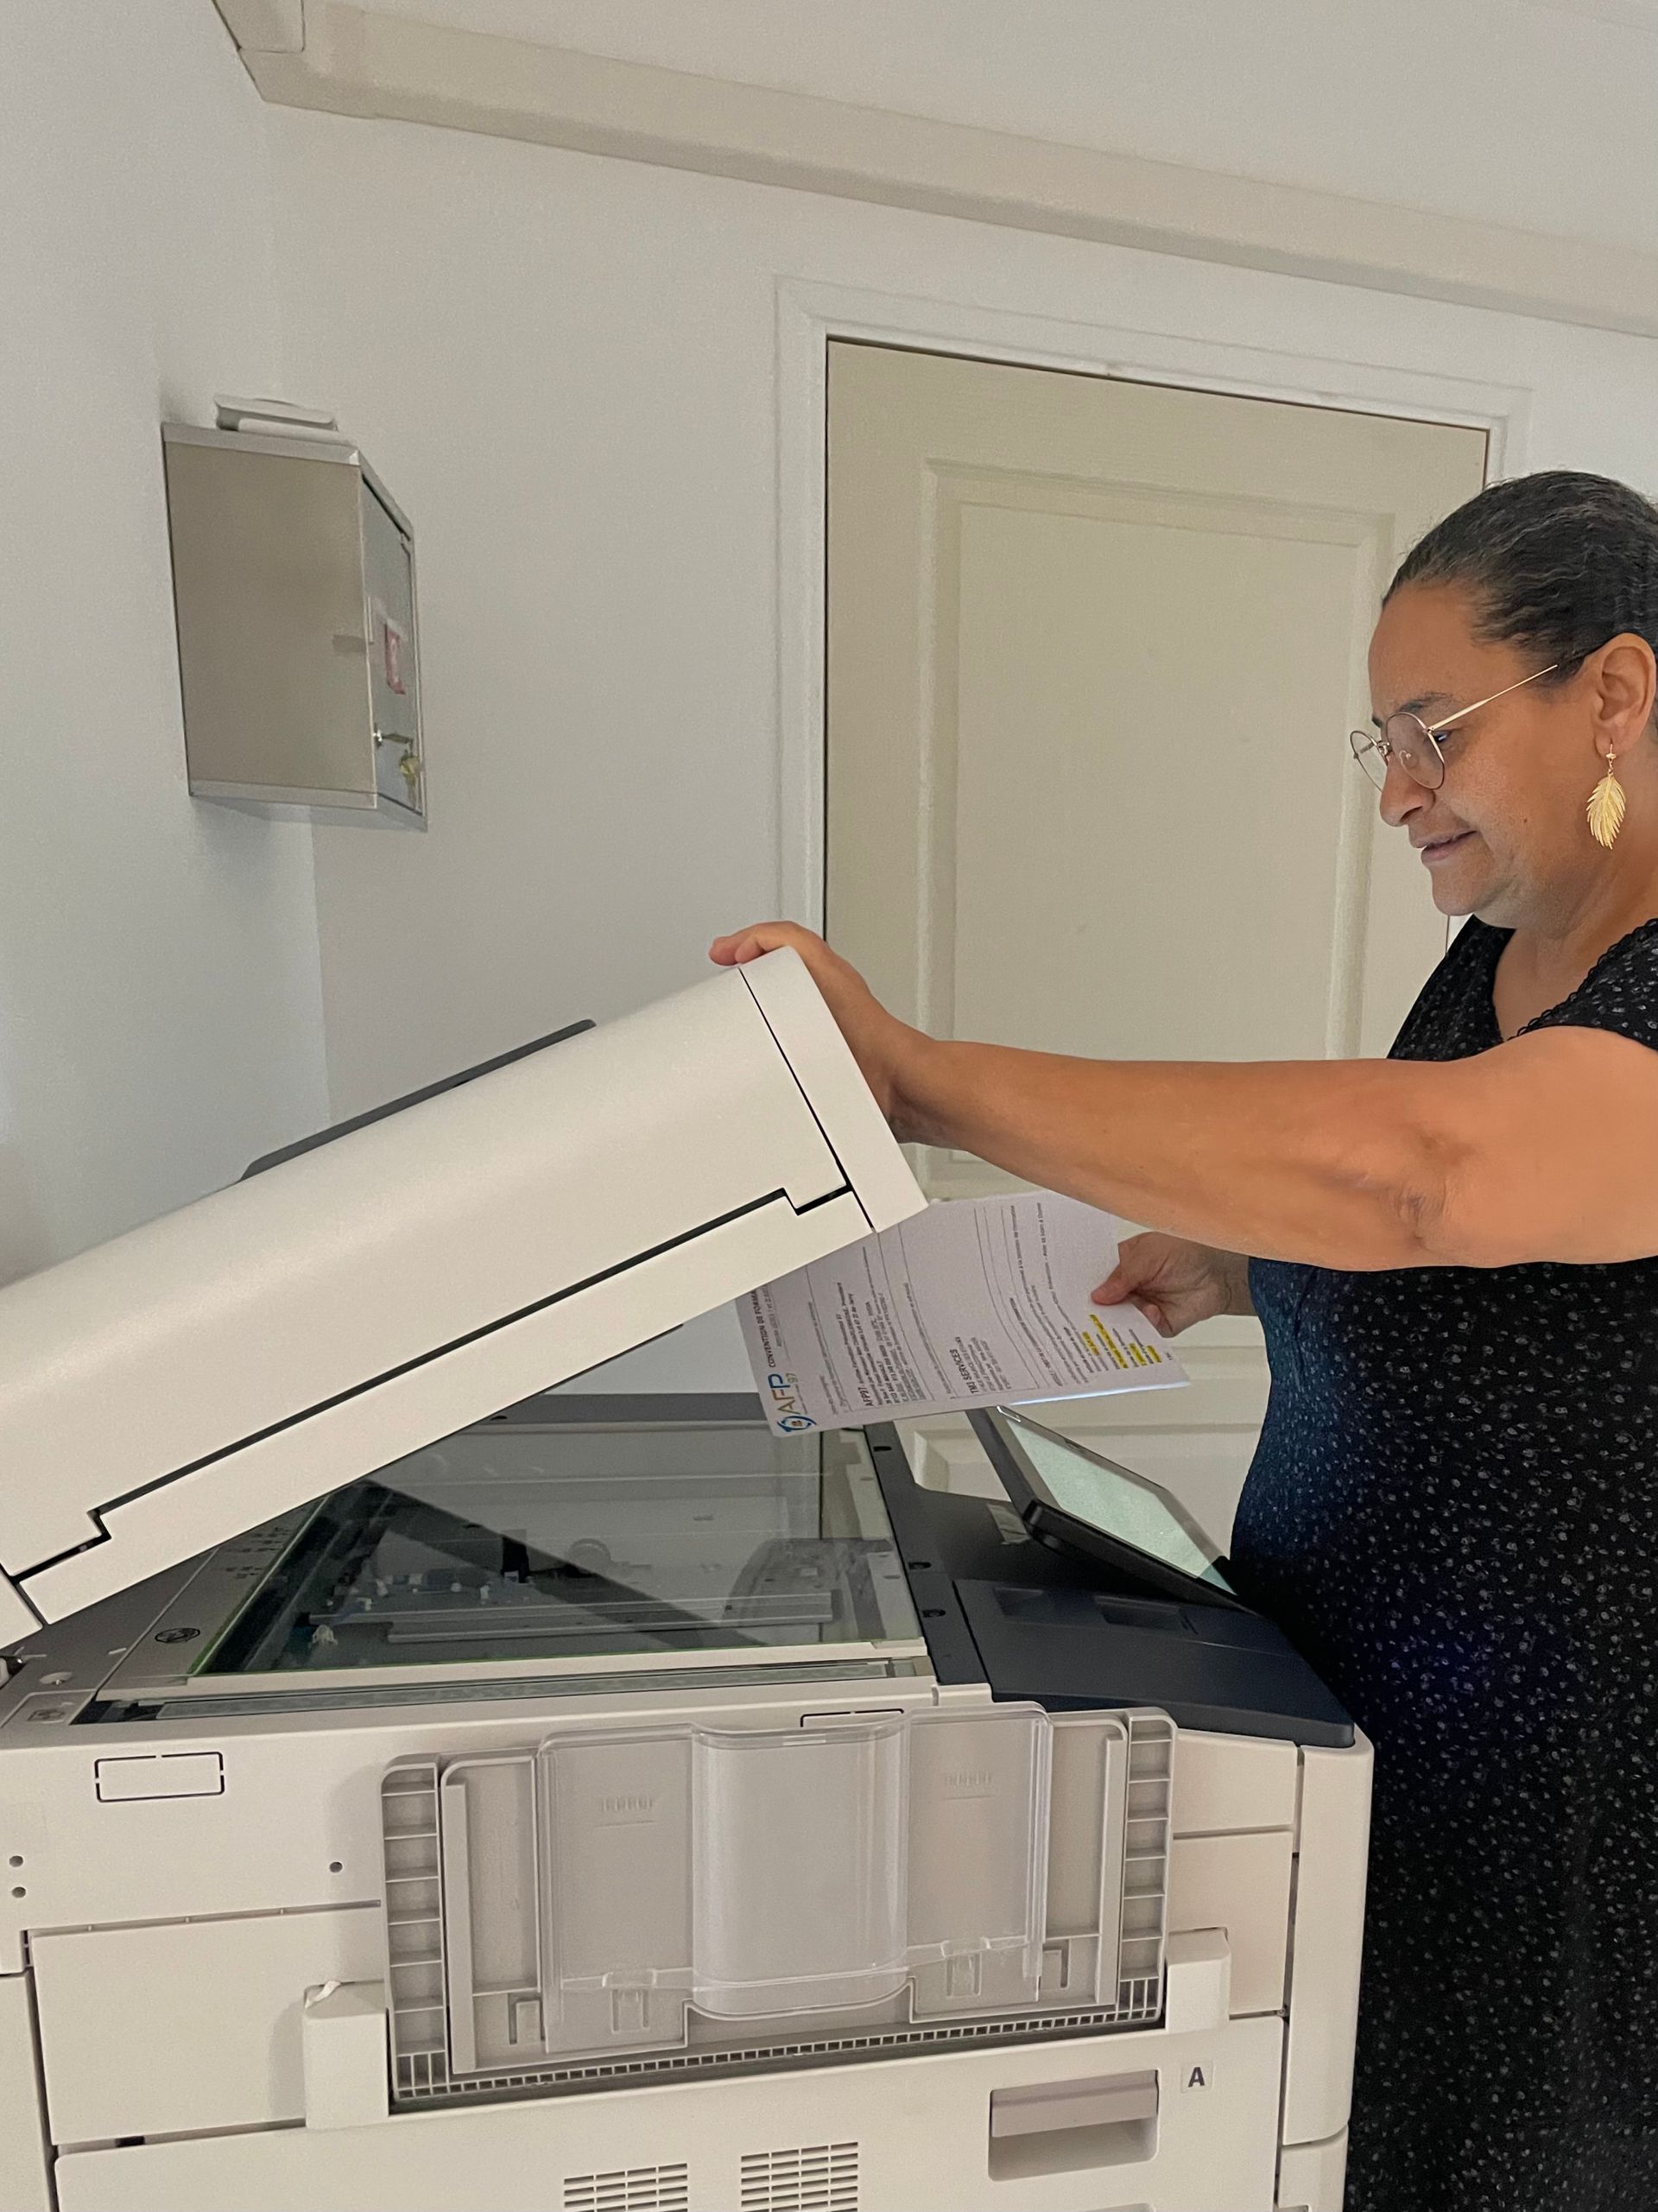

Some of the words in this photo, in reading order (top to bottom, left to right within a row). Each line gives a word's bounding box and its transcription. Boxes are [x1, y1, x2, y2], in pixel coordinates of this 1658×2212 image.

[949, 1349, 972, 1380] SERVICES
[768, 1373, 801, 1415] AFP
[1188, 2067, 1205, 2088] A
